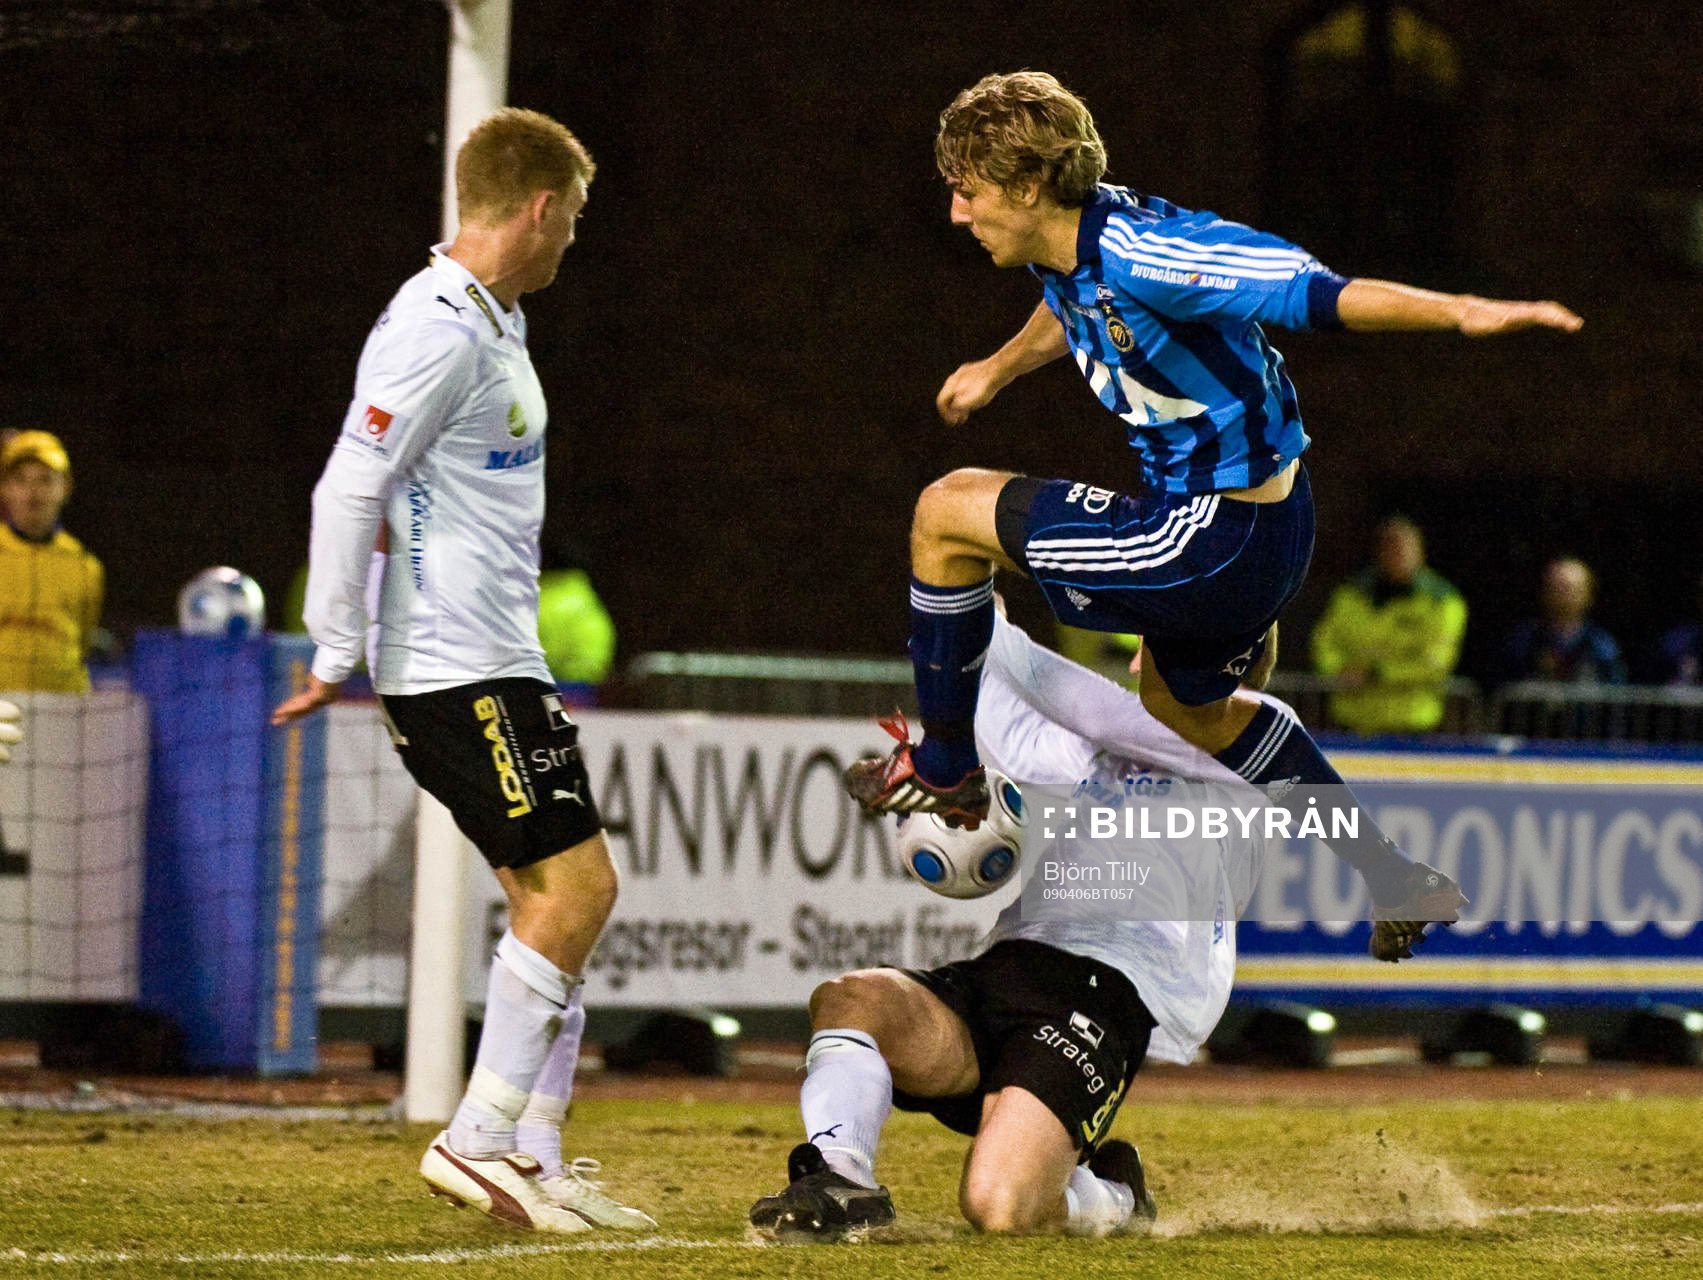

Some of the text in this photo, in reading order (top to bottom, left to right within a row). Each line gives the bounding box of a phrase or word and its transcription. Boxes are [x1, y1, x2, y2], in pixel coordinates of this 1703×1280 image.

[1198, 274, 1240, 290] ANDAN
[473, 696, 532, 818] LODAB
[531, 745, 576, 772] Str
[600, 741, 914, 883] ANWOR
[1089, 975, 1098, 988] 4
[1033, 1025, 1105, 1094] Strateg
